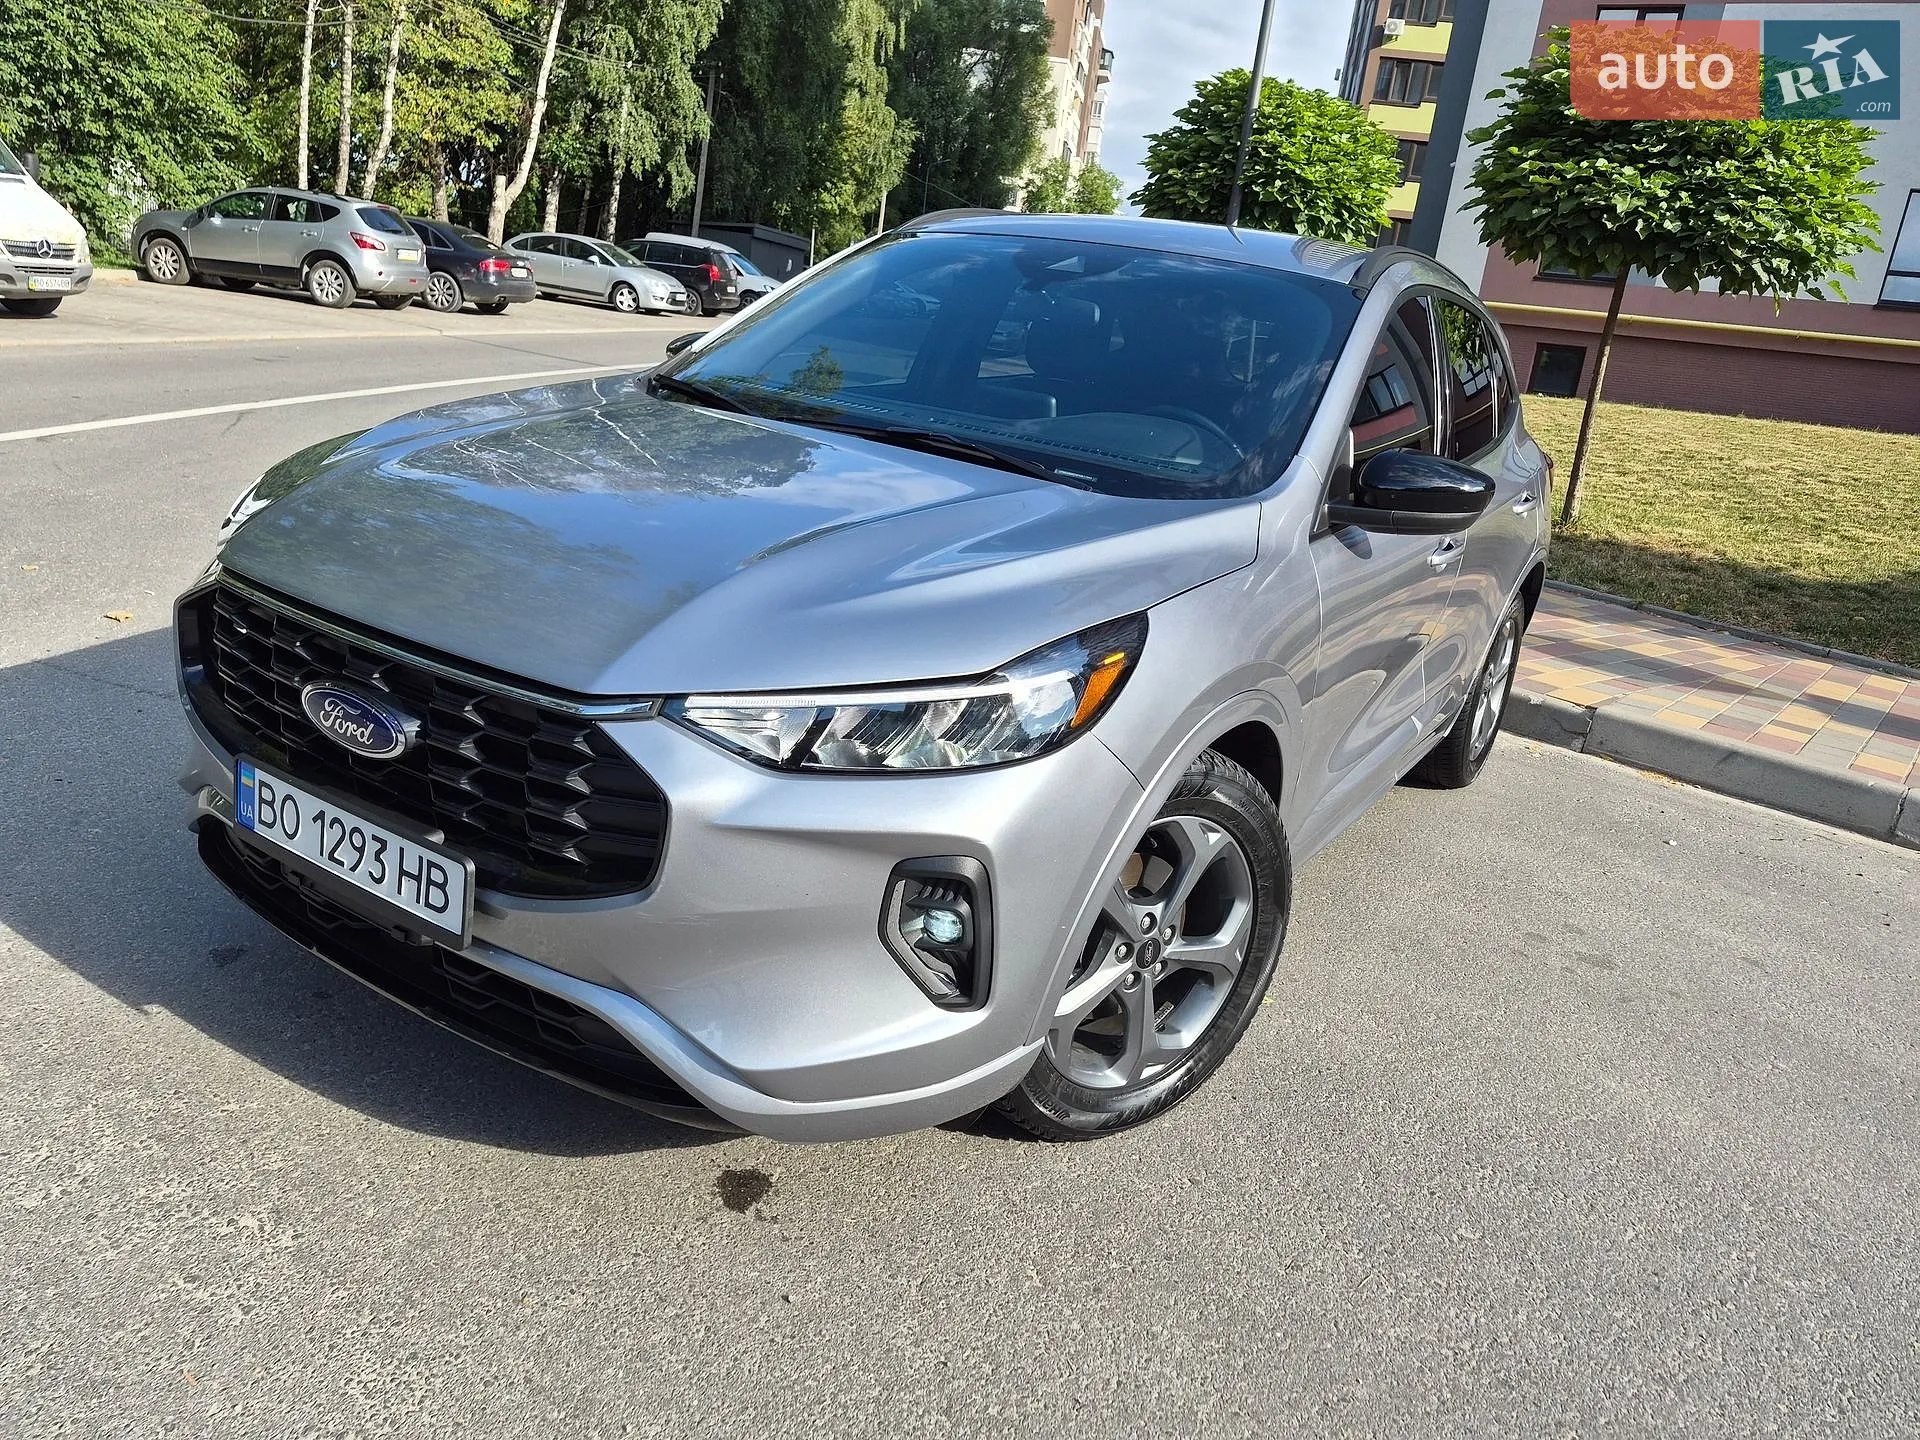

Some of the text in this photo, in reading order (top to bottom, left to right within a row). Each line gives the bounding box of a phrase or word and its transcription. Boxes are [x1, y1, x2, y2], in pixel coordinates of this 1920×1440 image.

[319, 697, 373, 745] Ford
[240, 801, 254, 819] UA
[258, 780, 449, 913] BO 1293 HB
